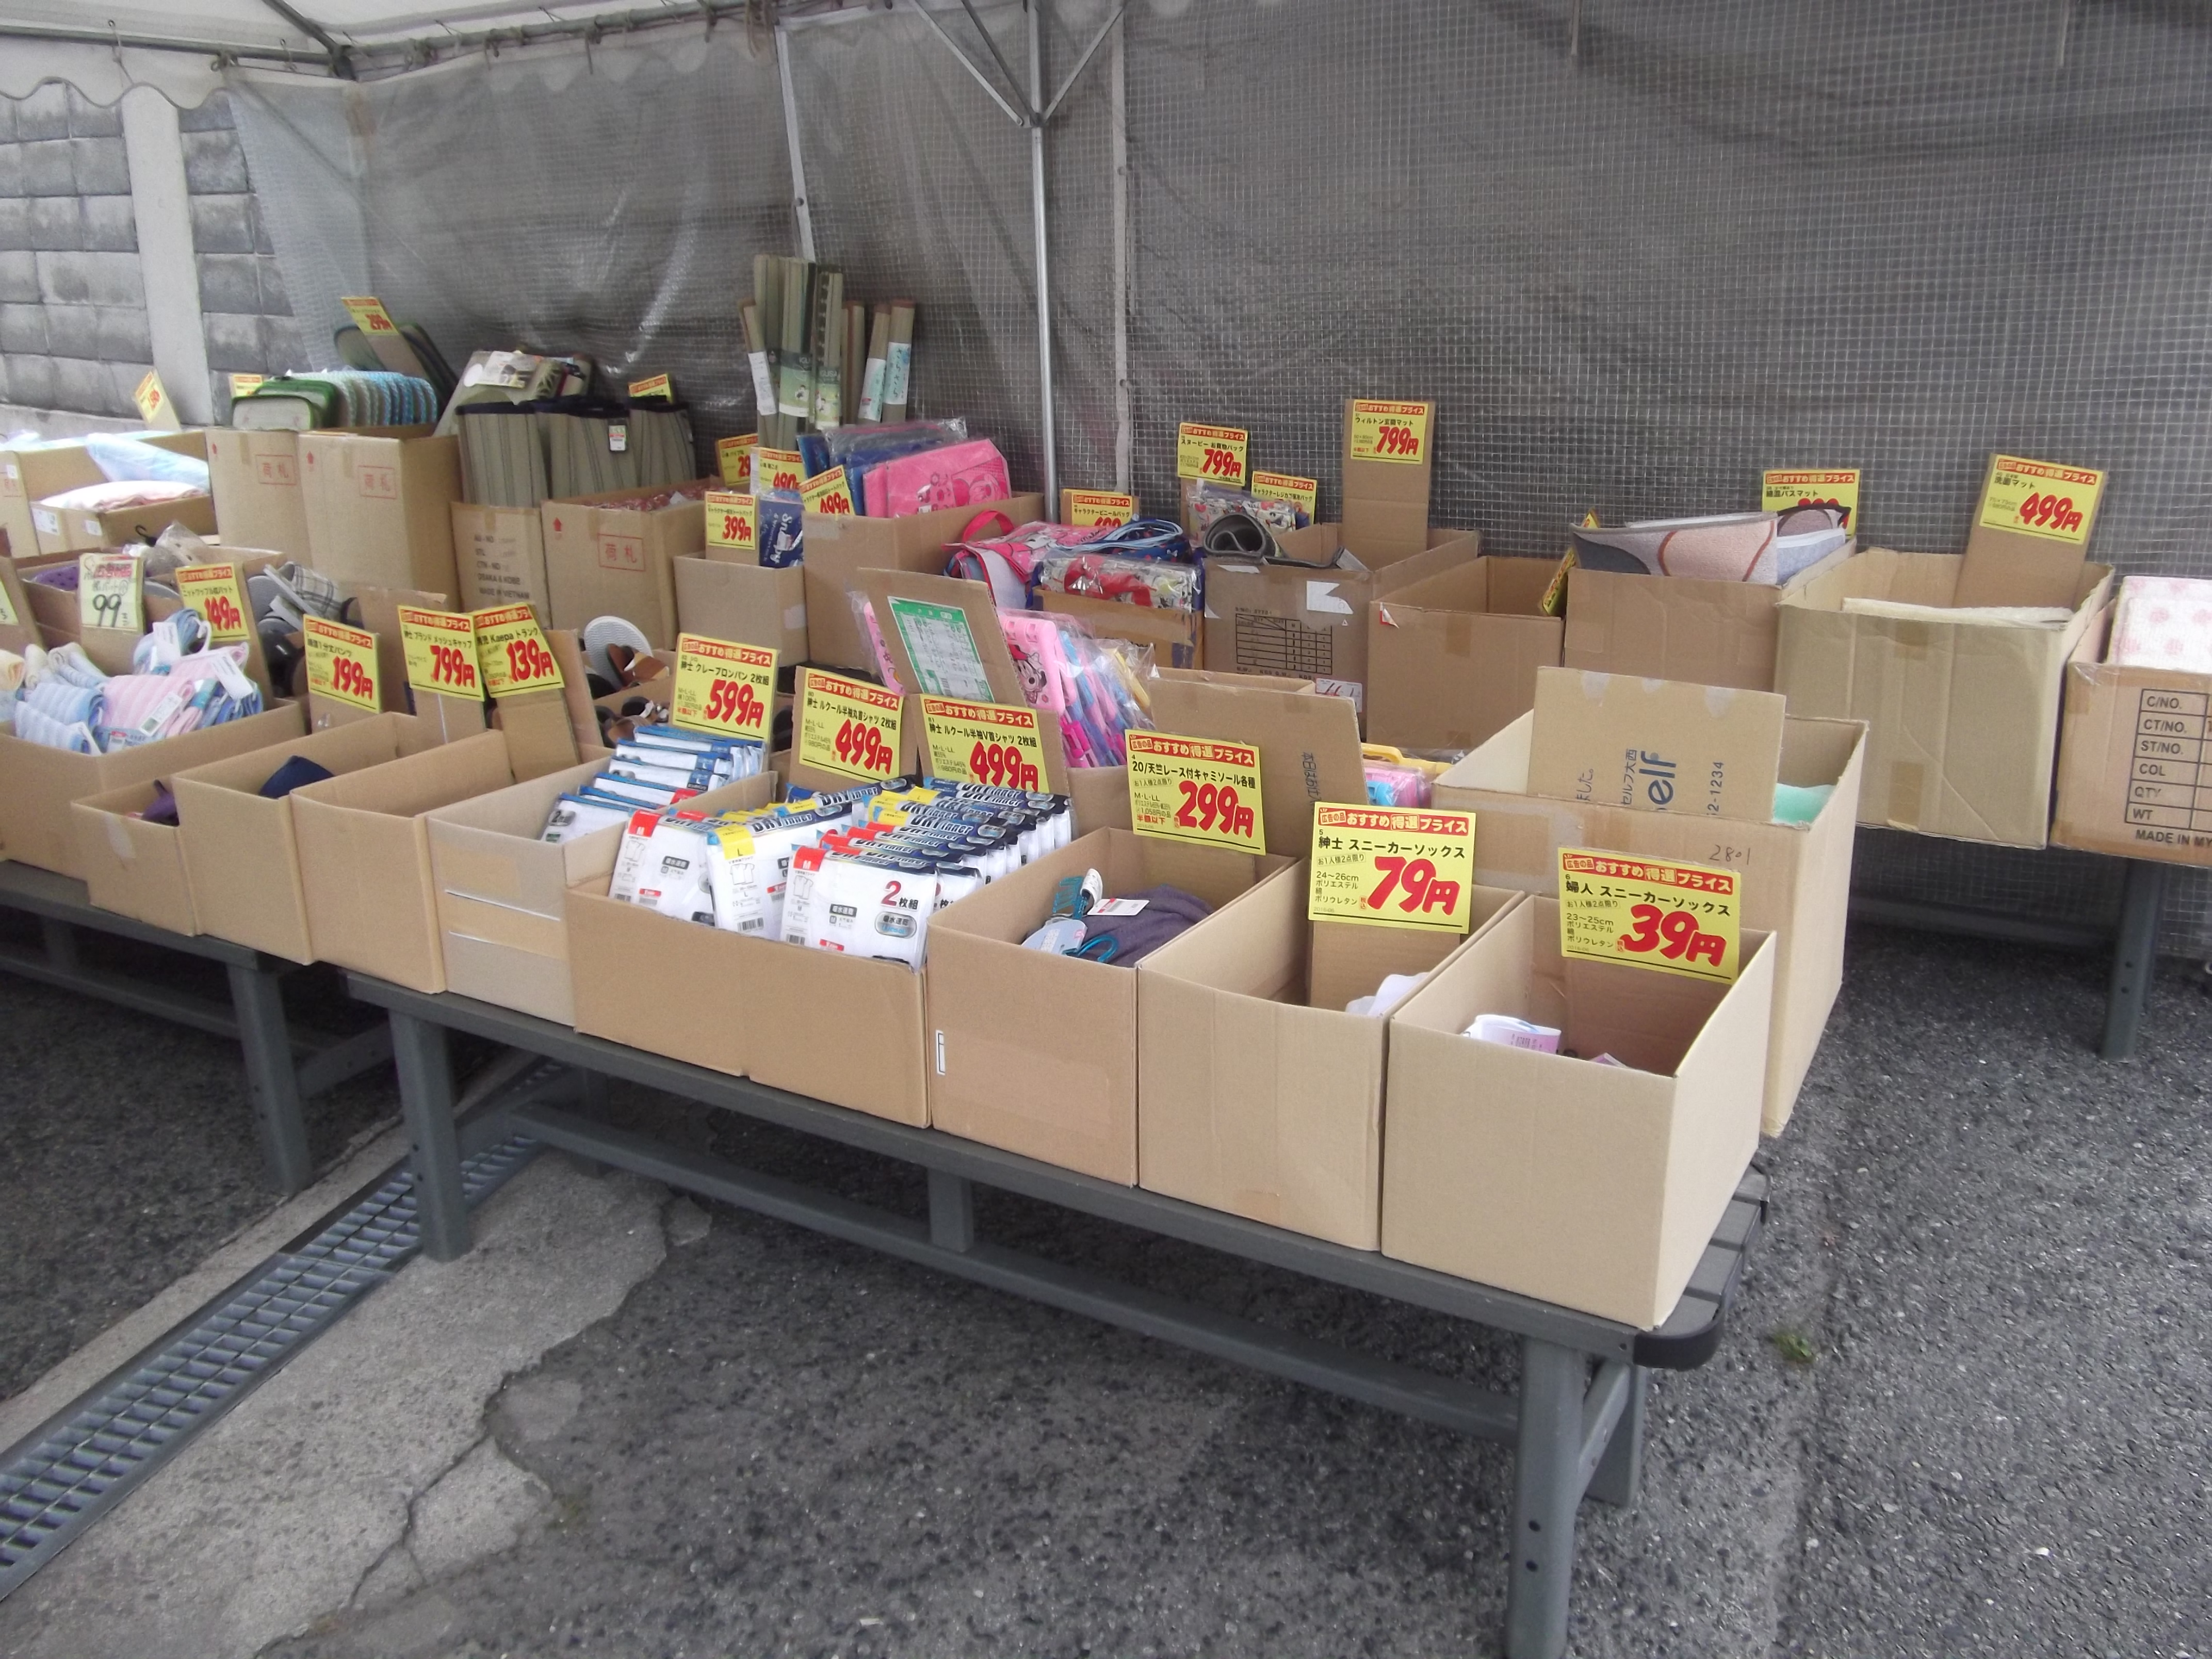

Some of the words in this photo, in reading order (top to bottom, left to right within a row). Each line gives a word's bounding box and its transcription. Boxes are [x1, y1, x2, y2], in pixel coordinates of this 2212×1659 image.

[1376, 426, 1419, 456] 799円
[1202, 448, 1242, 478] 799円
[1074, 508, 1130, 517] キャラクタービニールバッグ
[2020, 492, 2084, 533] 499円
[723, 515, 752, 542] 399円
[204, 596, 241, 631] 149円
[434, 637, 471, 649] メッシュキャップ
[491, 633, 514, 643] Kaepa
[430, 645, 475, 689] 799円
[506, 639, 555, 682] 139円
[333, 656, 373, 701] 199円
[751, 673, 769, 686] 2枚組
[706, 679, 765, 729] 599円
[807, 697, 817, 708] 紳士
[820, 700, 879, 725] ルクール半袖丸首シャツ
[881, 717, 897, 730] 2枚組
[2146, 695, 2182, 710] C/NO.
[929, 723, 942, 734] 紳士
[945, 725, 1015, 744] ルクール半袖V首シャツ
[1017, 736, 1037, 748] 2枚組
[2143, 719, 2187, 733] CT/NO.
[835, 718, 893, 775] 499円
[2141, 740, 2184, 755] ST/NO.
[970, 740, 1038, 792] 499円
[1132, 761, 1256, 789] 20/天竺レース付キャミソール各種
[2139, 763, 2166, 777] COL
[1621, 749, 1637, 806] セルフ大西
[1638, 751, 1677, 811] elf
[2135, 786, 2161, 799] QTY
[1175, 780, 1255, 839] 299円
[2133, 808, 2153, 820] WT
[637, 826, 645, 835] M
[753, 817, 784, 833] DRY
[1321, 812, 1346, 823] 広告の品
[1347, 813, 1467, 834] おすすめ得選プライス
[1319, 836, 1343, 850] 紳士
[1348, 839, 1466, 859] スニーカーソックス
[2136, 829, 2173, 843] MADE
[2177, 834, 2190, 845] IN
[737, 848, 743, 856] L
[1318, 854, 1365, 866] お1人様2点限り
[803, 860, 811, 870] M
[1566, 859, 1593, 870] 広告の品
[1595, 860, 1732, 893] おすすめ得選プライス
[881, 880, 919, 910] 2枚組
[1316, 880, 1358, 890] ポリエステル
[1368, 856, 1460, 916] 79円
[1315, 896, 1358, 905] ポリウレタン
[1360, 896, 1367, 910] 税込
[1566, 881, 1593, 896] 婦人
[1600, 885, 1731, 917] スニーカーソックス
[1567, 900, 1618, 908] お1人様2点限り
[1567, 920, 1614, 934] ポリエステル
[1620, 904, 1727, 967] 39円
[1567, 935, 1614, 948] ポリウレタン
